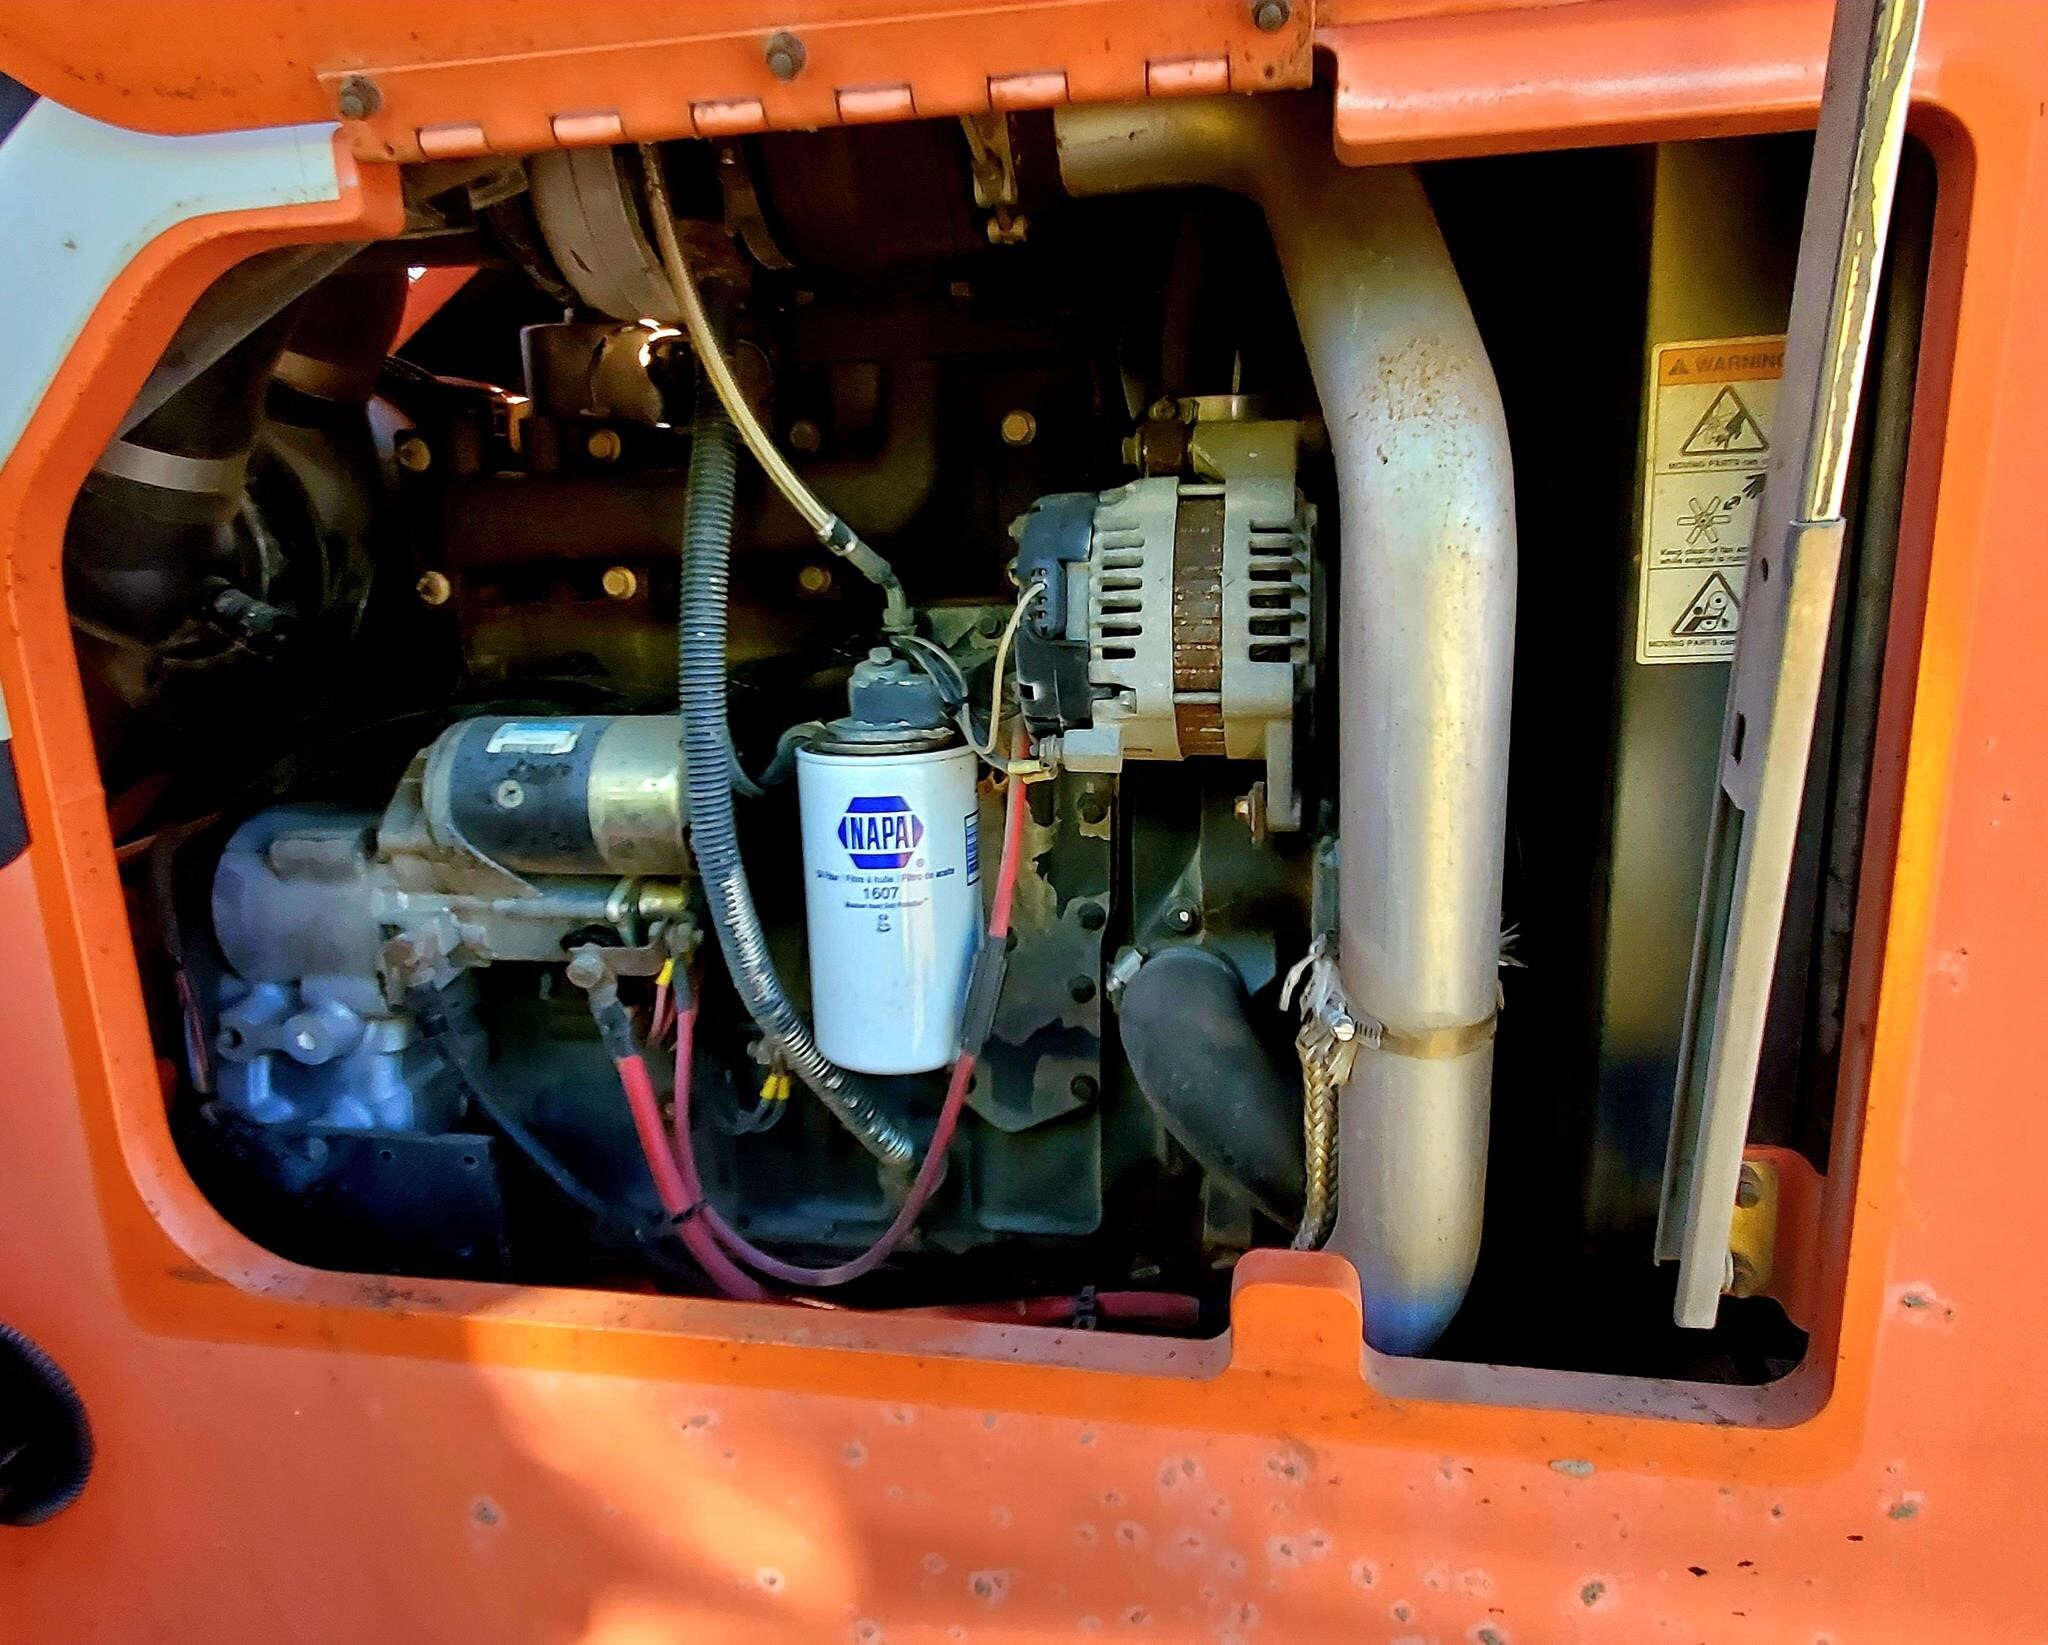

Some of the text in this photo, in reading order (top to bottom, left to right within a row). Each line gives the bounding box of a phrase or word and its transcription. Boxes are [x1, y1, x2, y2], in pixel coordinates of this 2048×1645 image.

[1708, 458, 1740, 468] PARTS
[1648, 639, 1685, 648] MOVING
[1686, 638, 1718, 647] PARTS
[850, 815, 909, 850] NAPA
[863, 885, 900, 900] 1607
